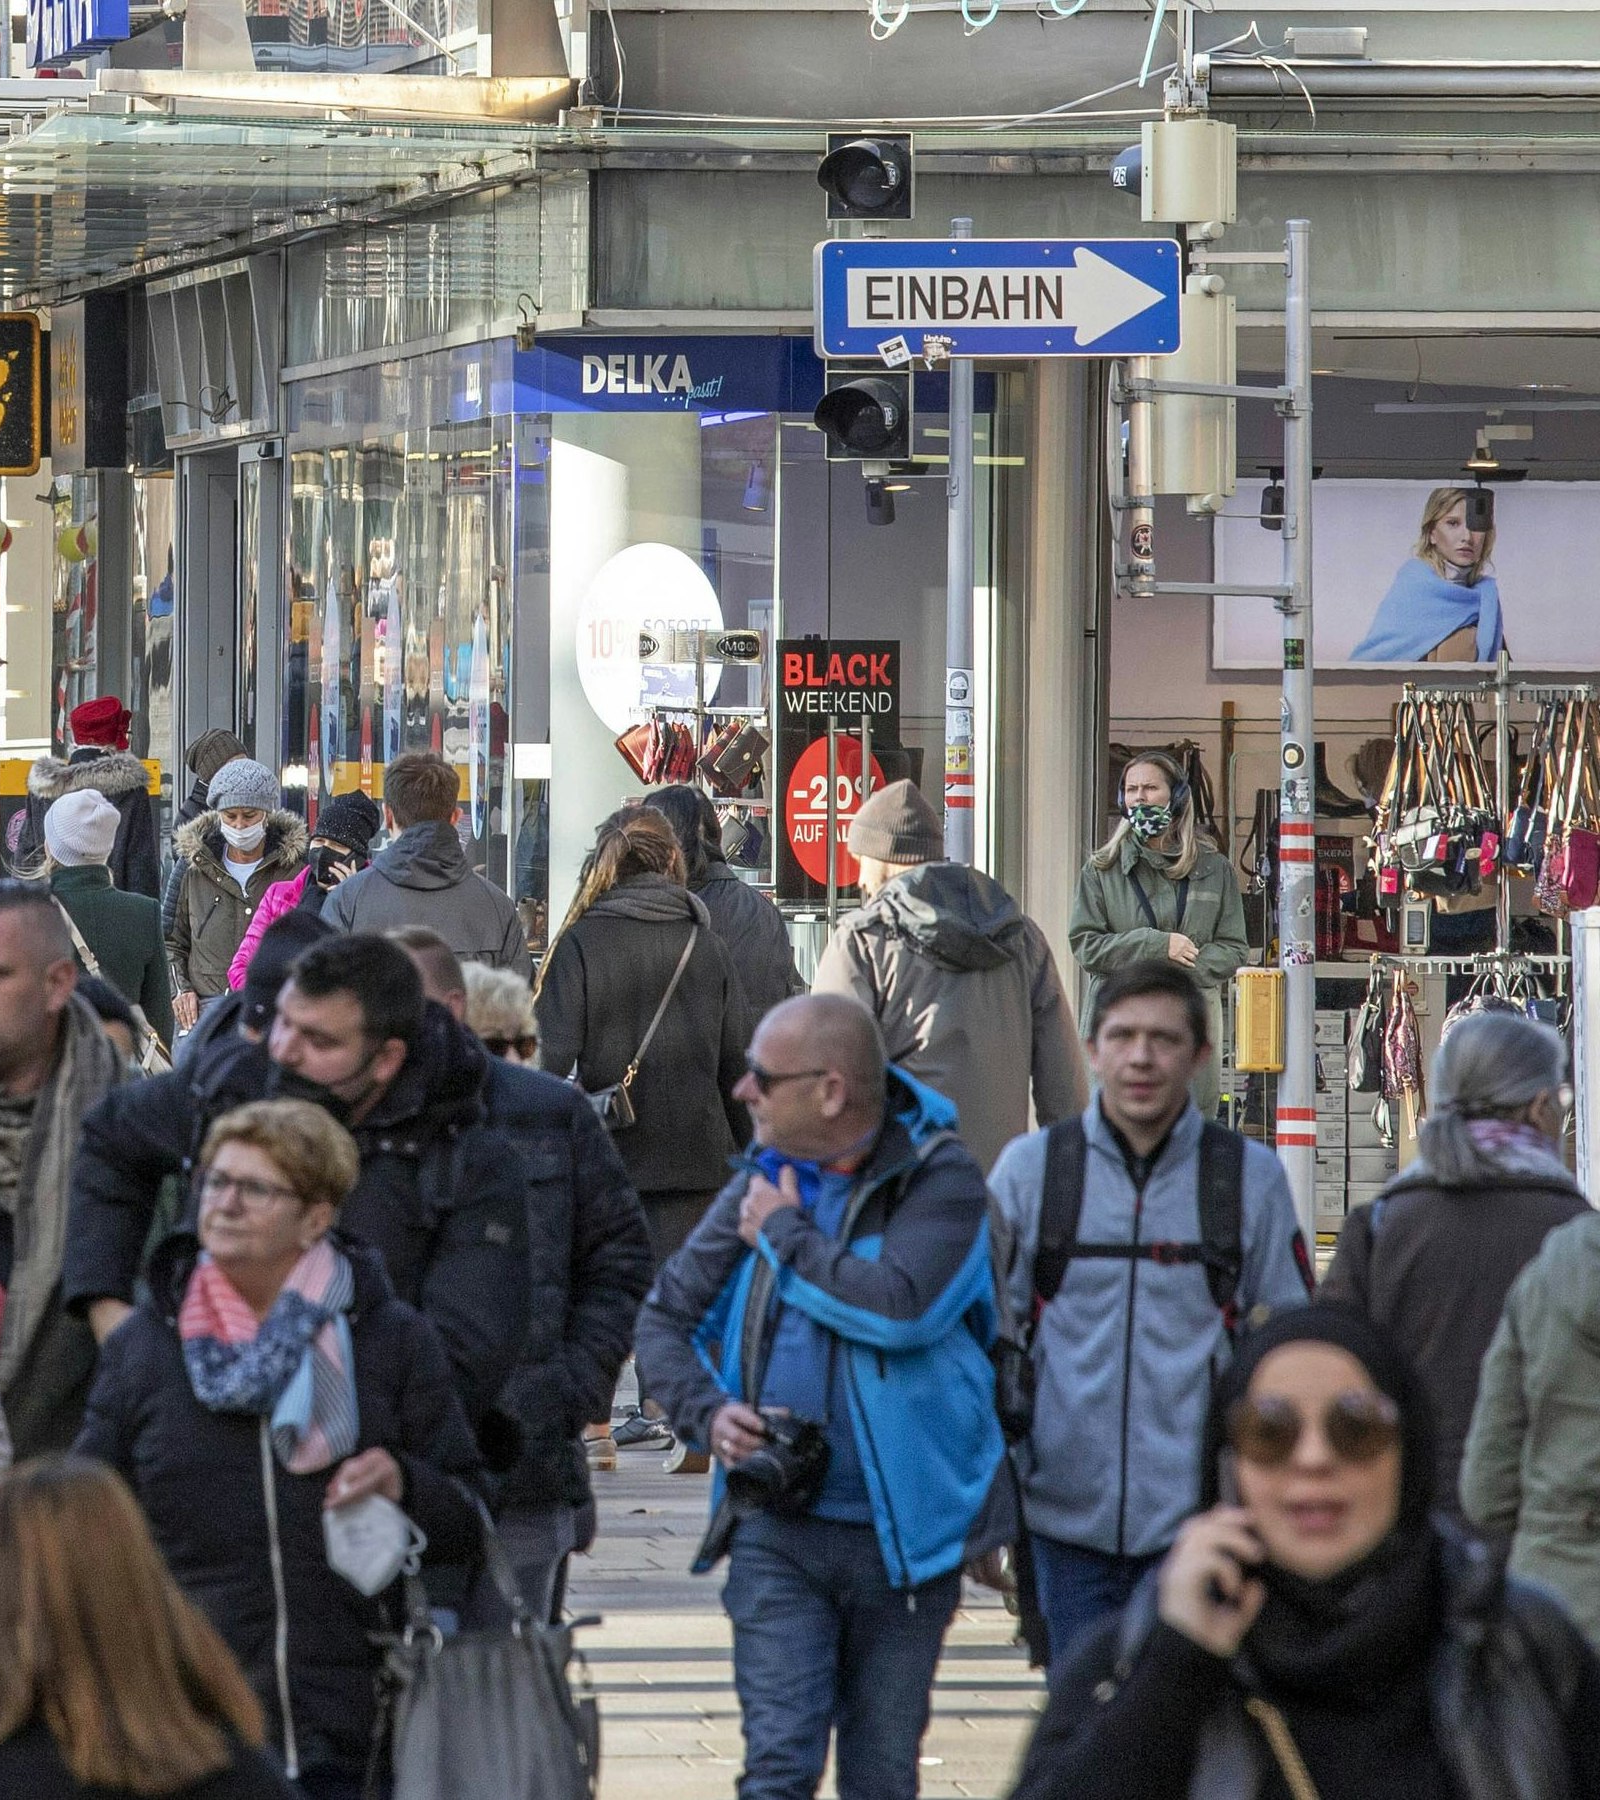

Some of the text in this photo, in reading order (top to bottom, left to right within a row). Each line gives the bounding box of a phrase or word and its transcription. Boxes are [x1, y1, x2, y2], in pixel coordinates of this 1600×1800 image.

[1114, 168, 1125, 184] 26
[866, 275, 1063, 320] EINBAHN
[582, 354, 694, 394] DELKA
[784, 653, 893, 687] BLACK
[784, 691, 893, 714] WEEKEND
[793, 824, 824, 843] AUF
